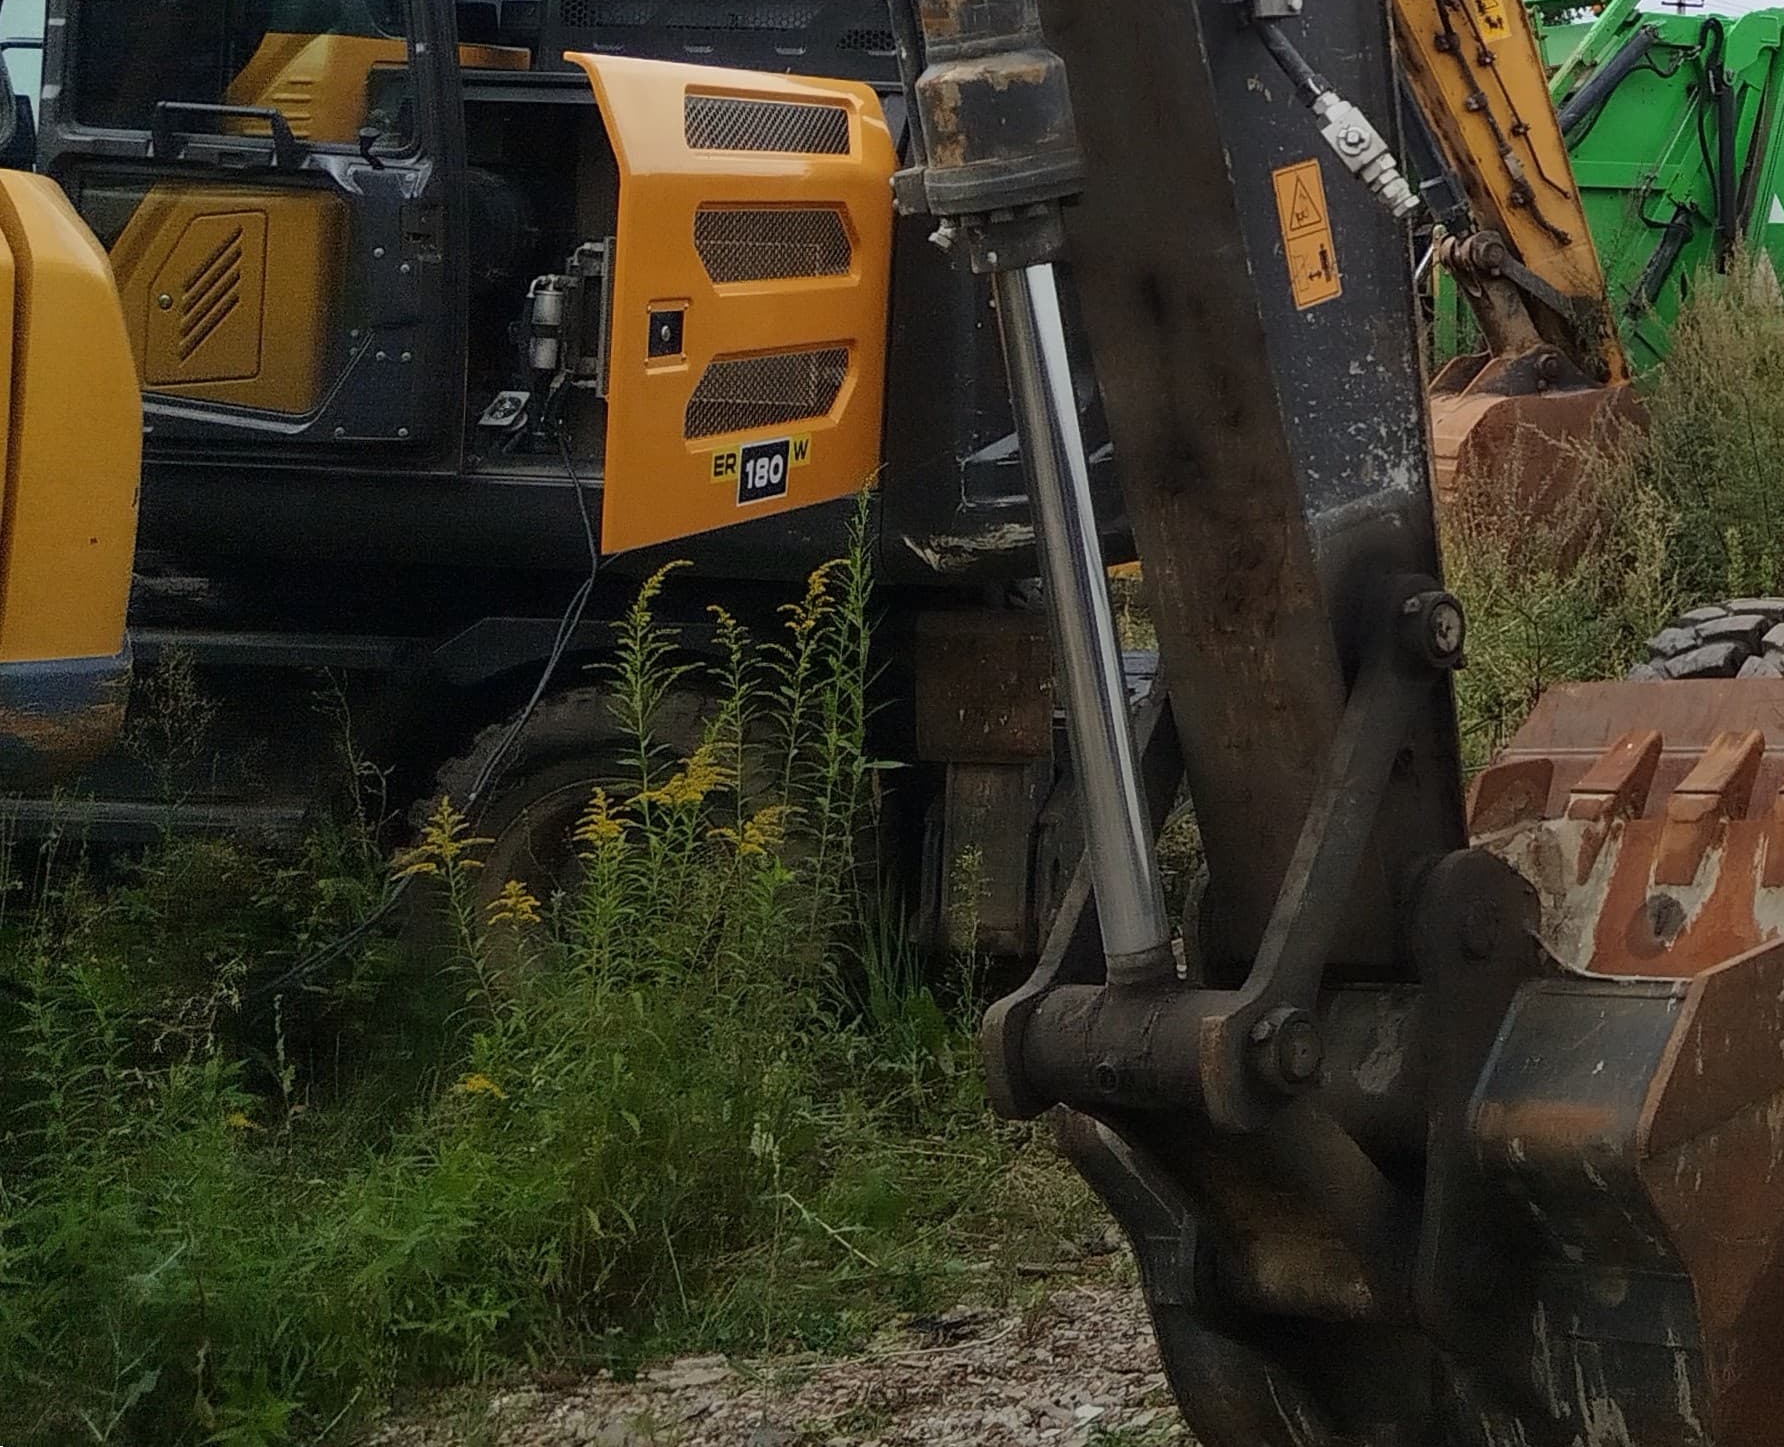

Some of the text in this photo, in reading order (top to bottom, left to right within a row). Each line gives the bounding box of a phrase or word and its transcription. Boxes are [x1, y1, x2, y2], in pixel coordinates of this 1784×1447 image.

[713, 438, 809, 490] ER 180 W
